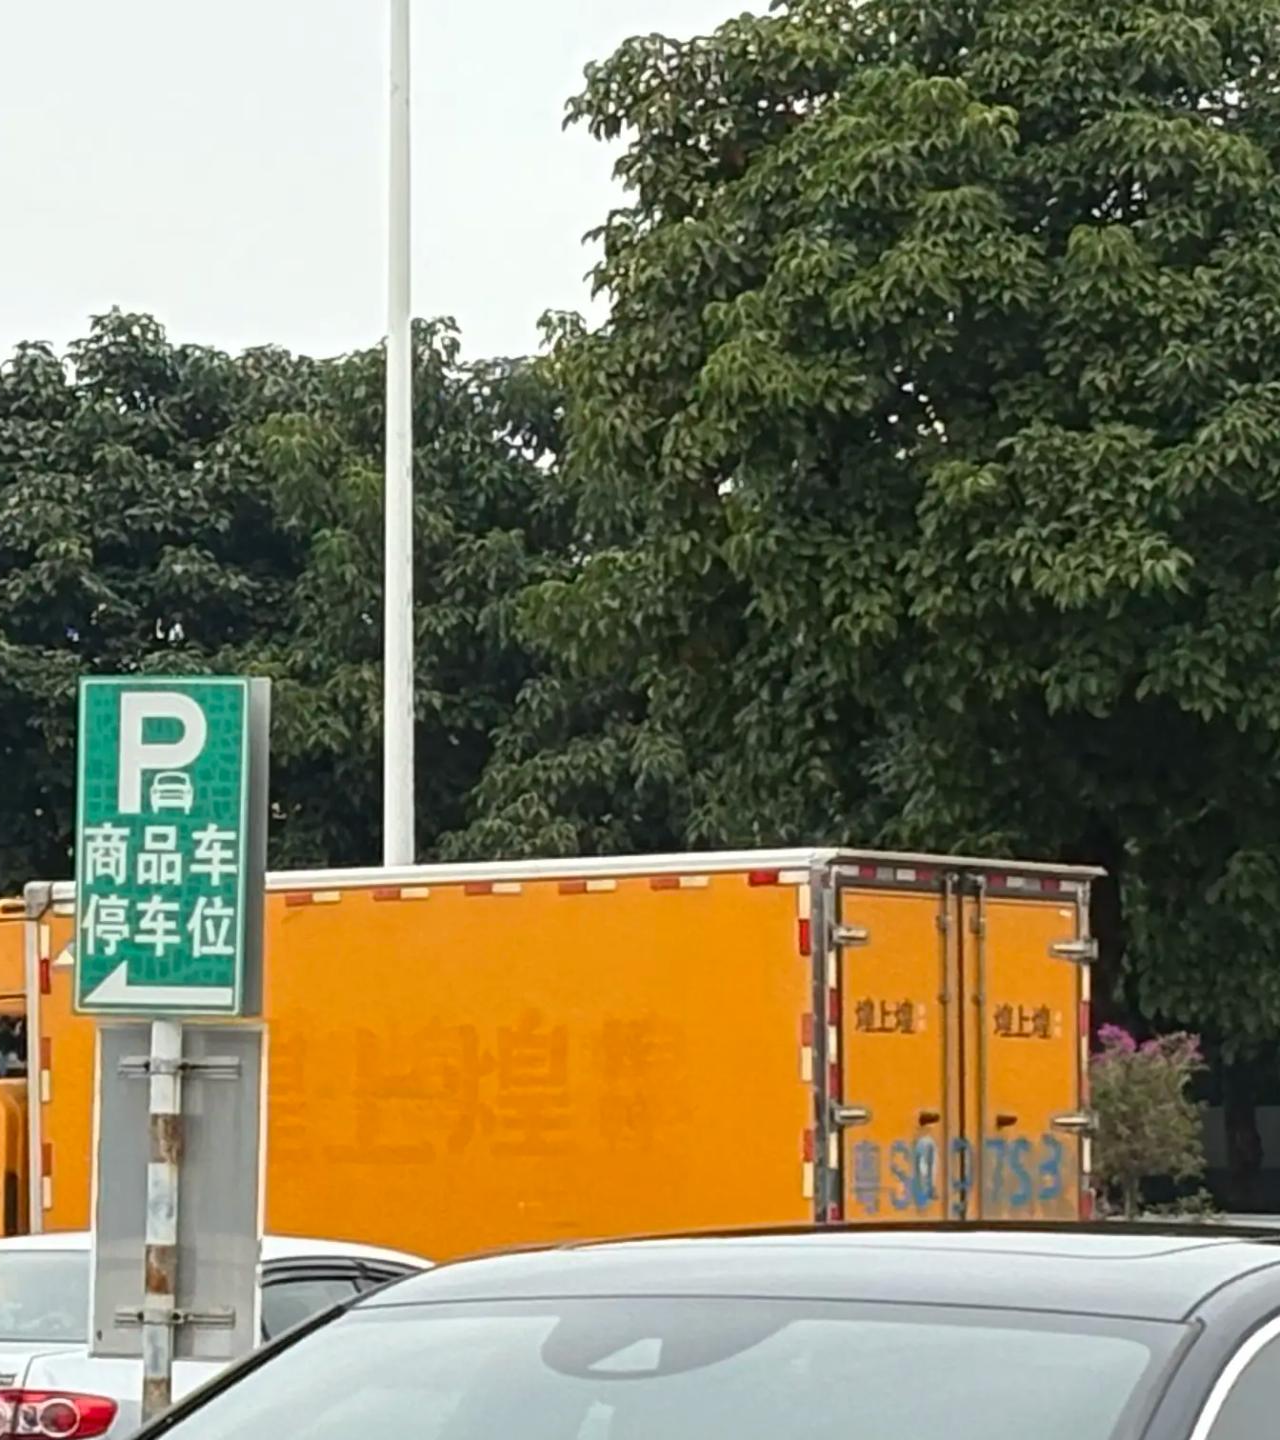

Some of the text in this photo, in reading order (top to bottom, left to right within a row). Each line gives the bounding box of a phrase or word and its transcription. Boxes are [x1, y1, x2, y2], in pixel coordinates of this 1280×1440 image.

[118, 691, 208, 814] P
[83, 822, 238, 886] 商品车
[81, 894, 235, 957] 停车位
